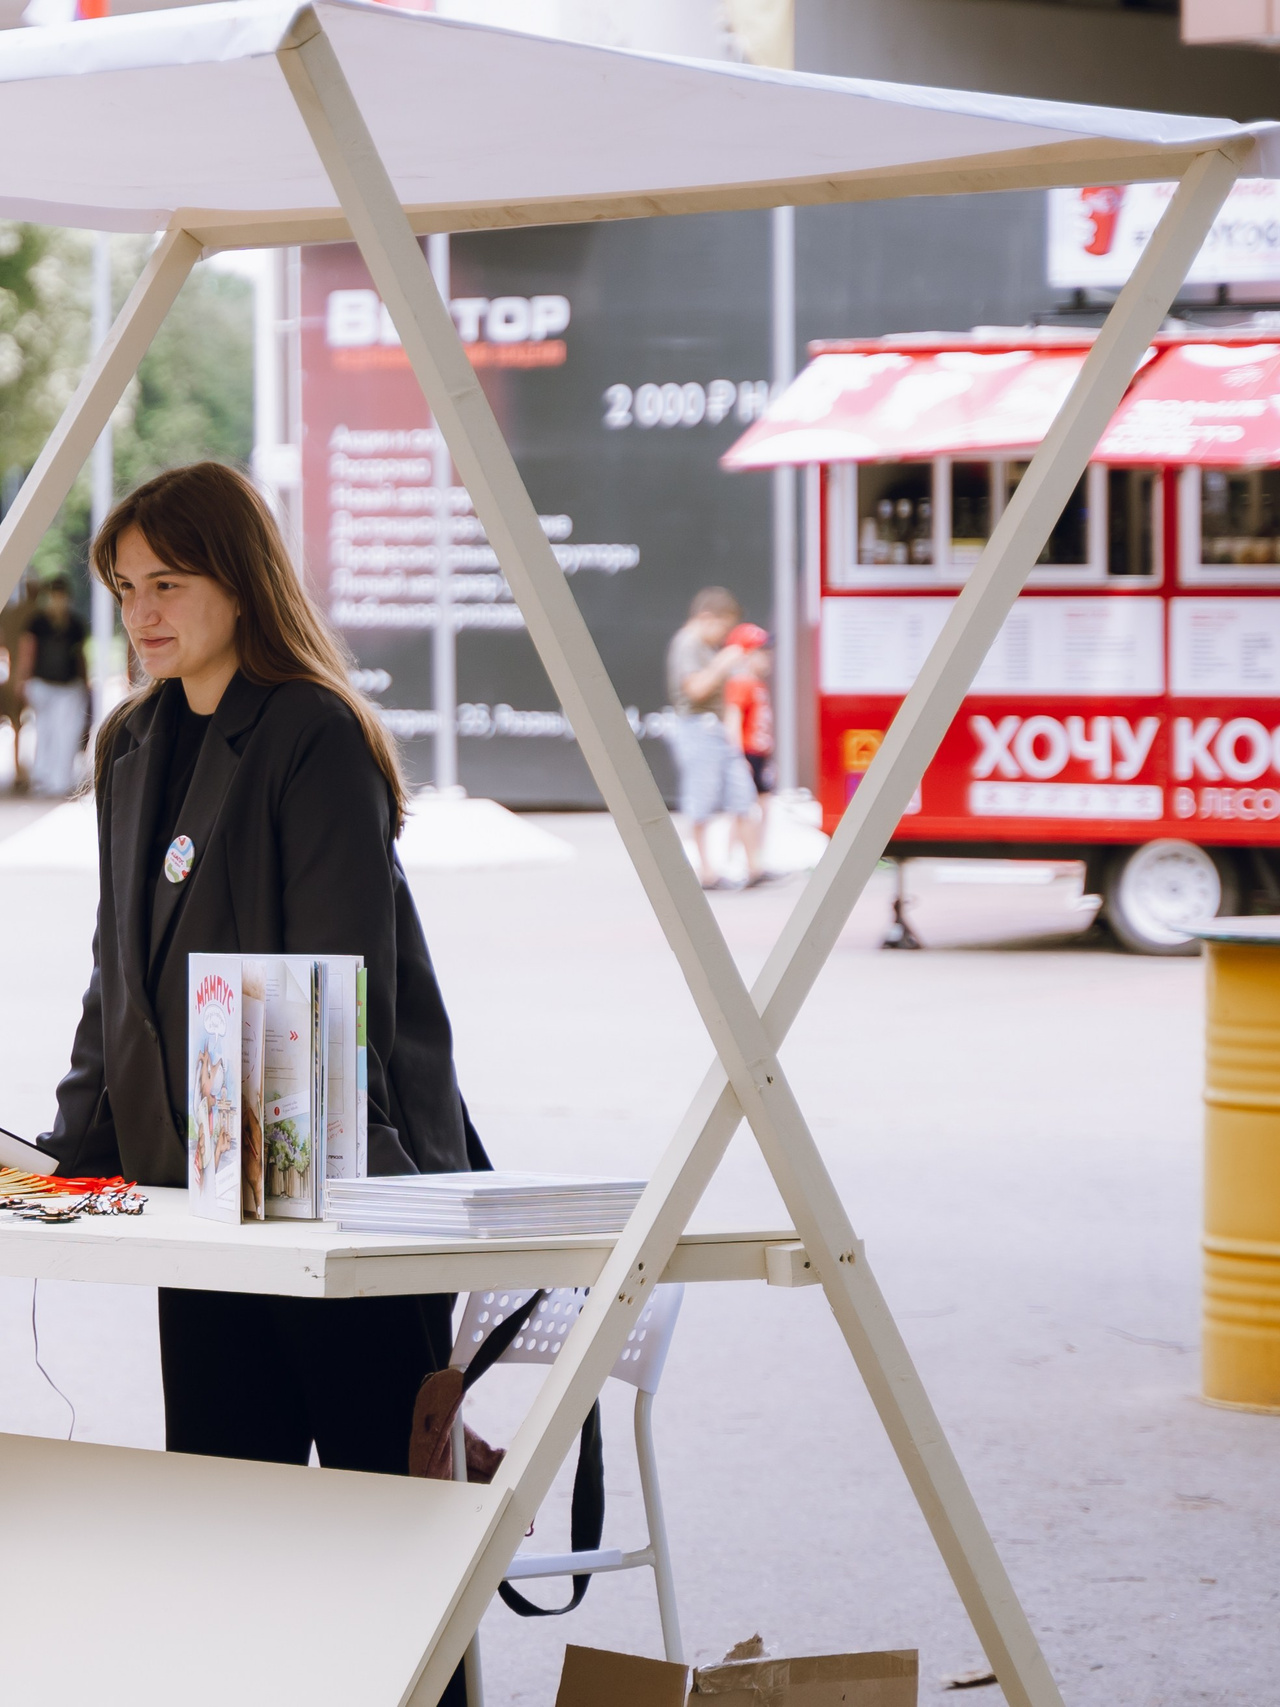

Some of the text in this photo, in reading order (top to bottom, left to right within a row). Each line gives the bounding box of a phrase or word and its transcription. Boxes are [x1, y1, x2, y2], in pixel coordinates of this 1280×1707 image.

[971, 714, 1280, 782] ХОЧУ КО
[195, 974, 235, 1015] МАМПУС
